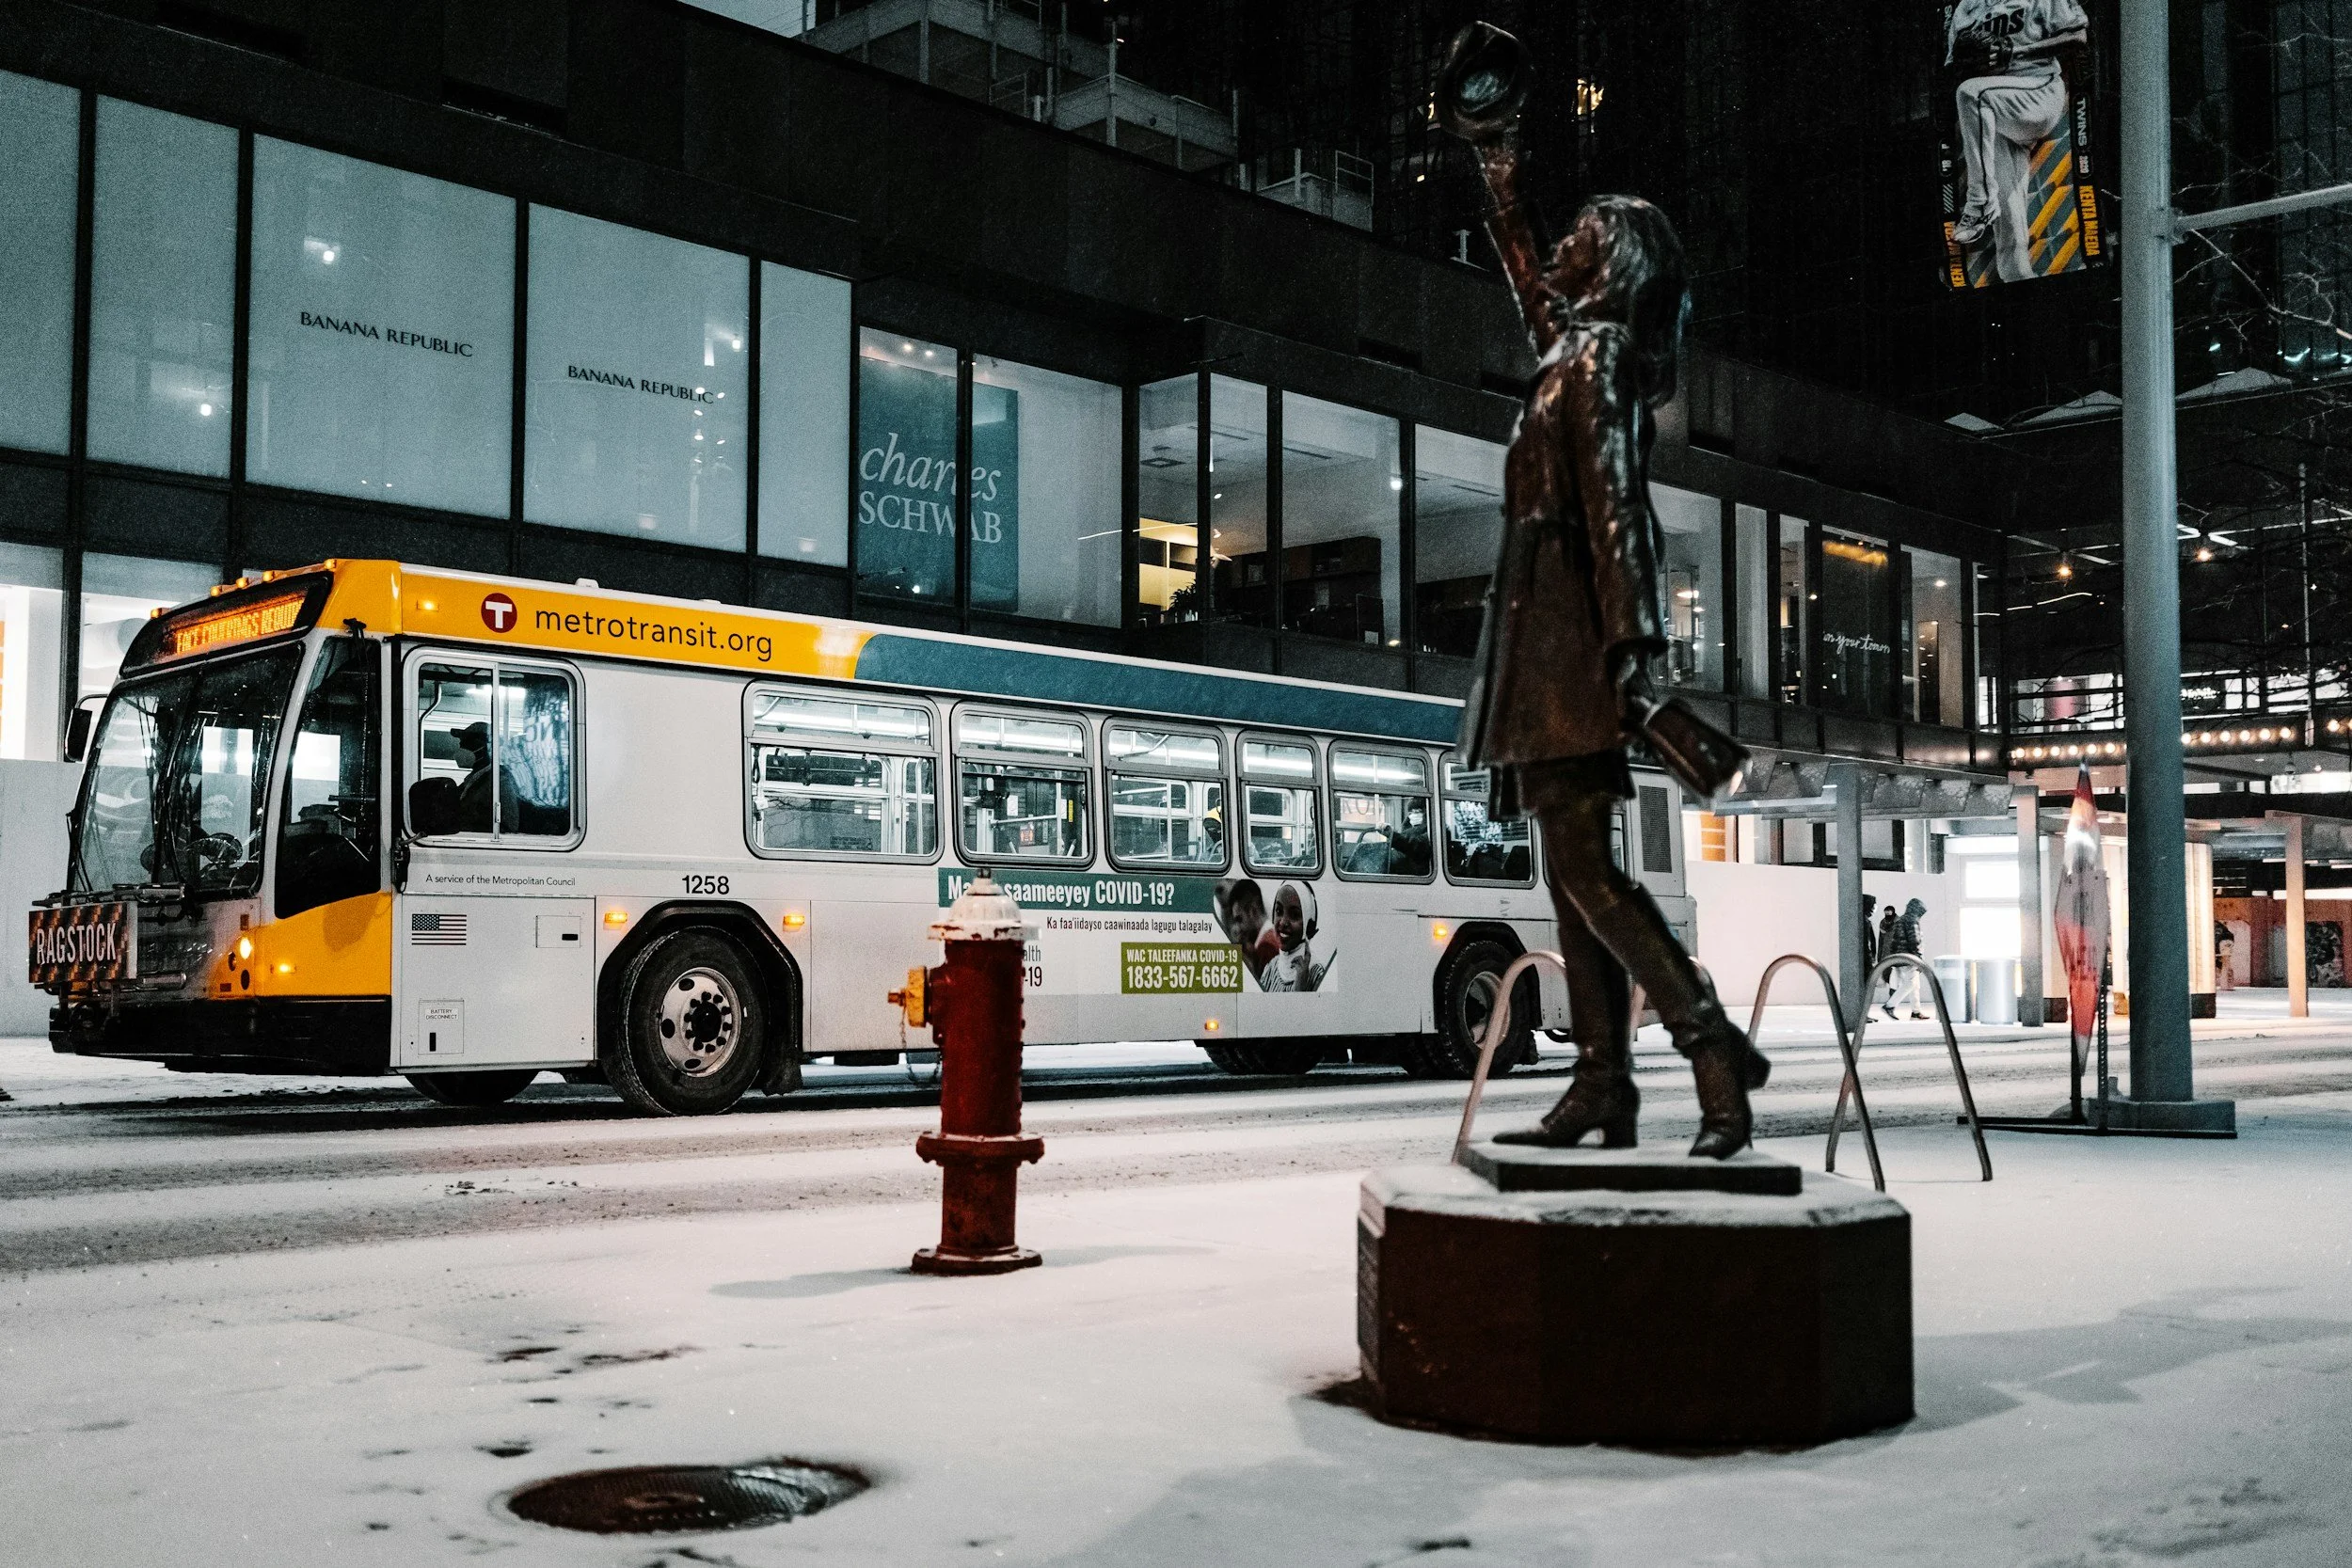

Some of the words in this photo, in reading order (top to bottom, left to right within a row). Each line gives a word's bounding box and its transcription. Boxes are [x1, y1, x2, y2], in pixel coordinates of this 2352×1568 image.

[1979, 8, 2025, 38] ins
[2076, 98, 2088, 147] TWINS
[2079, 185, 2097, 220] KENTA
[2084, 219, 2101, 257] MAEDA
[1948, 256, 1967, 288] KENTA
[300, 311, 379, 340] BANANA
[387, 328, 473, 357] REPUBLIC
[567, 365, 635, 389] BANANA
[641, 379, 714, 404] REPUBLIC
[859, 432, 1002, 501] chares
[485, 600, 513, 629] T
[535, 610, 772, 662] metrotransit.org
[425, 874, 433, 883] A
[436, 875, 464, 884] service
[466, 875, 475, 884] of
[477, 875, 490, 884] the
[492, 876, 545, 887] Metropolitan
[547, 877, 576, 886] Council
[681, 874, 730, 895] 1258
[1004, 883, 1091, 908] saameeyey
[1095, 880, 1175, 906] COVID-19?
[1046, 916, 1057, 930] Ka
[1059, 918, 1102, 932] faa'iidayso
[1104, 919, 1150, 931] caawinaada
[1152, 920, 1177, 934] lagugu
[1179, 920, 1213, 934] talagalay
[37, 922, 117, 966] RAGSTOCK
[1126, 949, 1146, 963] WAC
[1148, 949, 1198, 963] TALEEFANKA
[1200, 949, 1238, 963] COVID-19
[1126, 965, 1238, 990] 1833-567-6662
